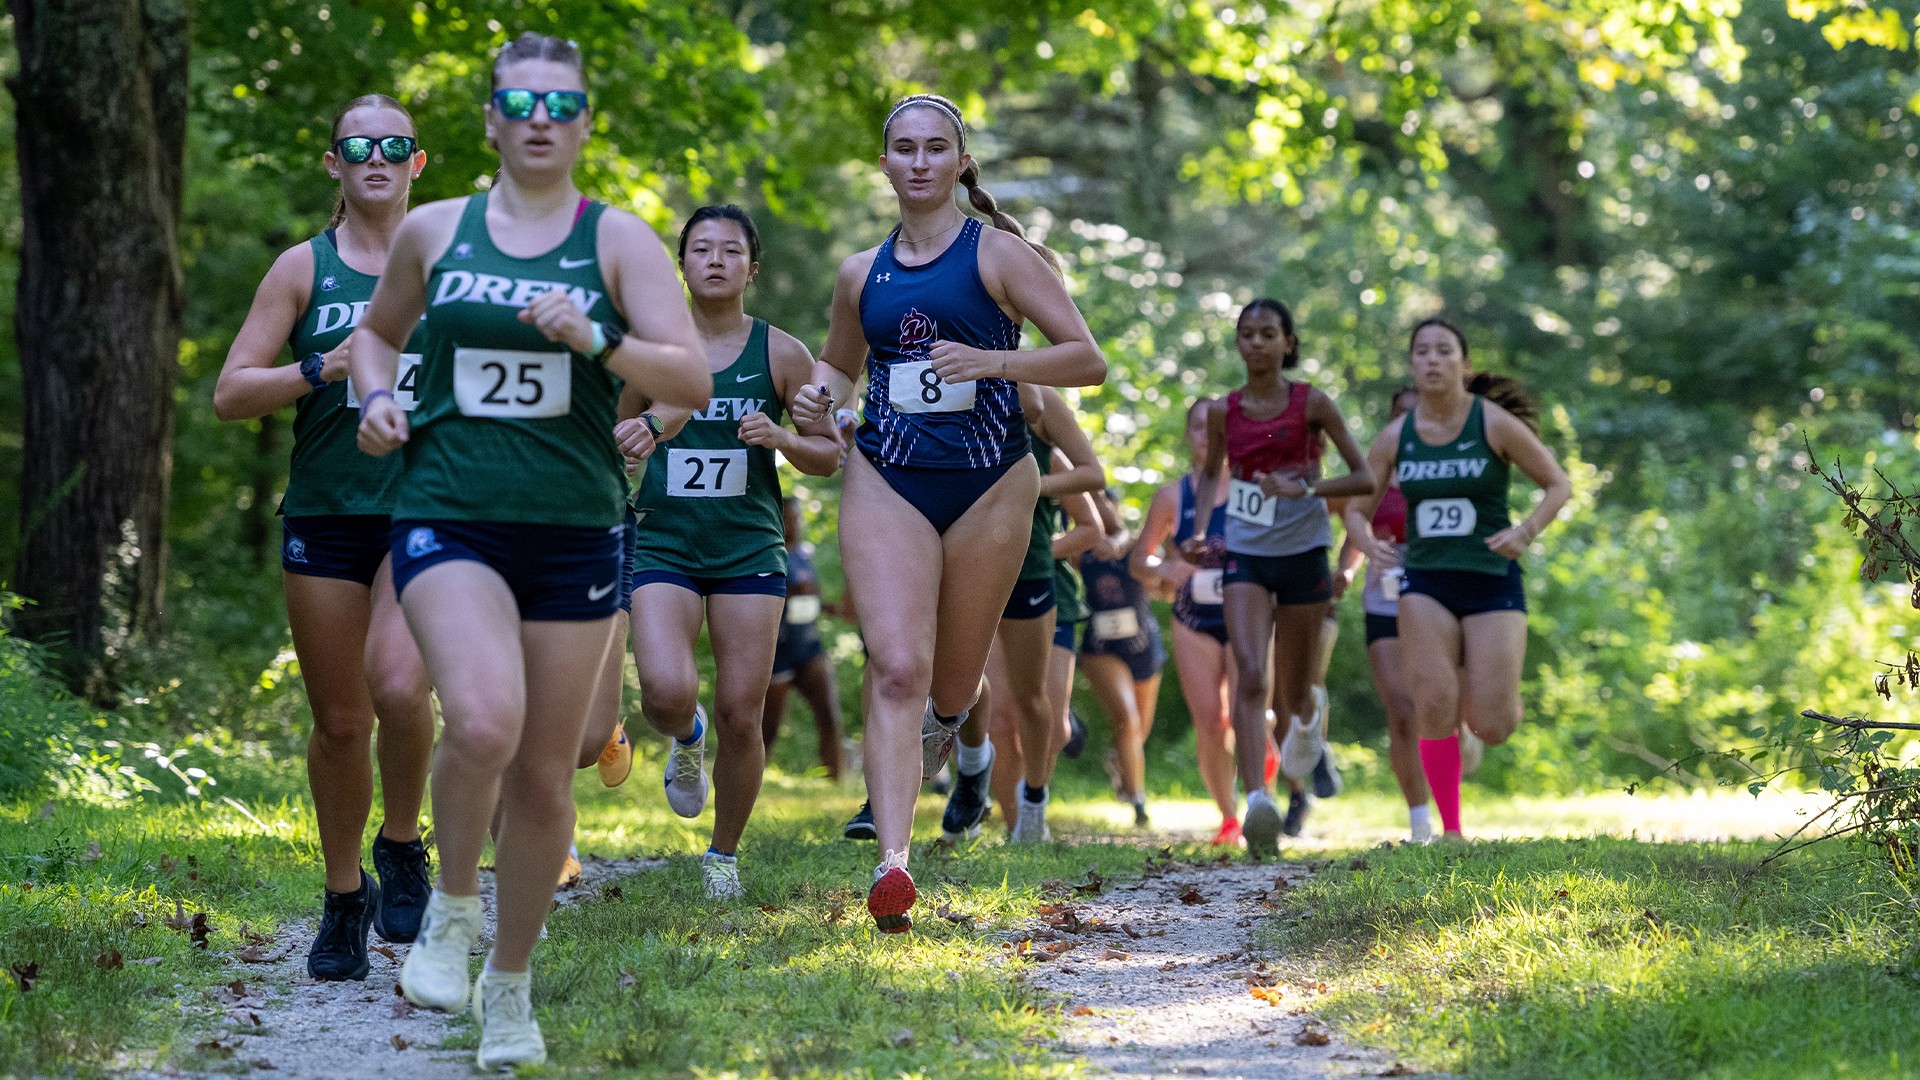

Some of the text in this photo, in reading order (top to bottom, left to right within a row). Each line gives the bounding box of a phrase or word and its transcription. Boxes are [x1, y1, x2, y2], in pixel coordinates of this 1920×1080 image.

[432, 270, 602, 315] DREW
[391, 363, 420, 402] 4
[480, 362, 544, 405] 25
[920, 368, 942, 404] 8
[684, 457, 731, 490] 27
[1397, 458, 1488, 482] DREW
[1237, 489, 1262, 516] 10
[1430, 505, 1462, 531] 29
